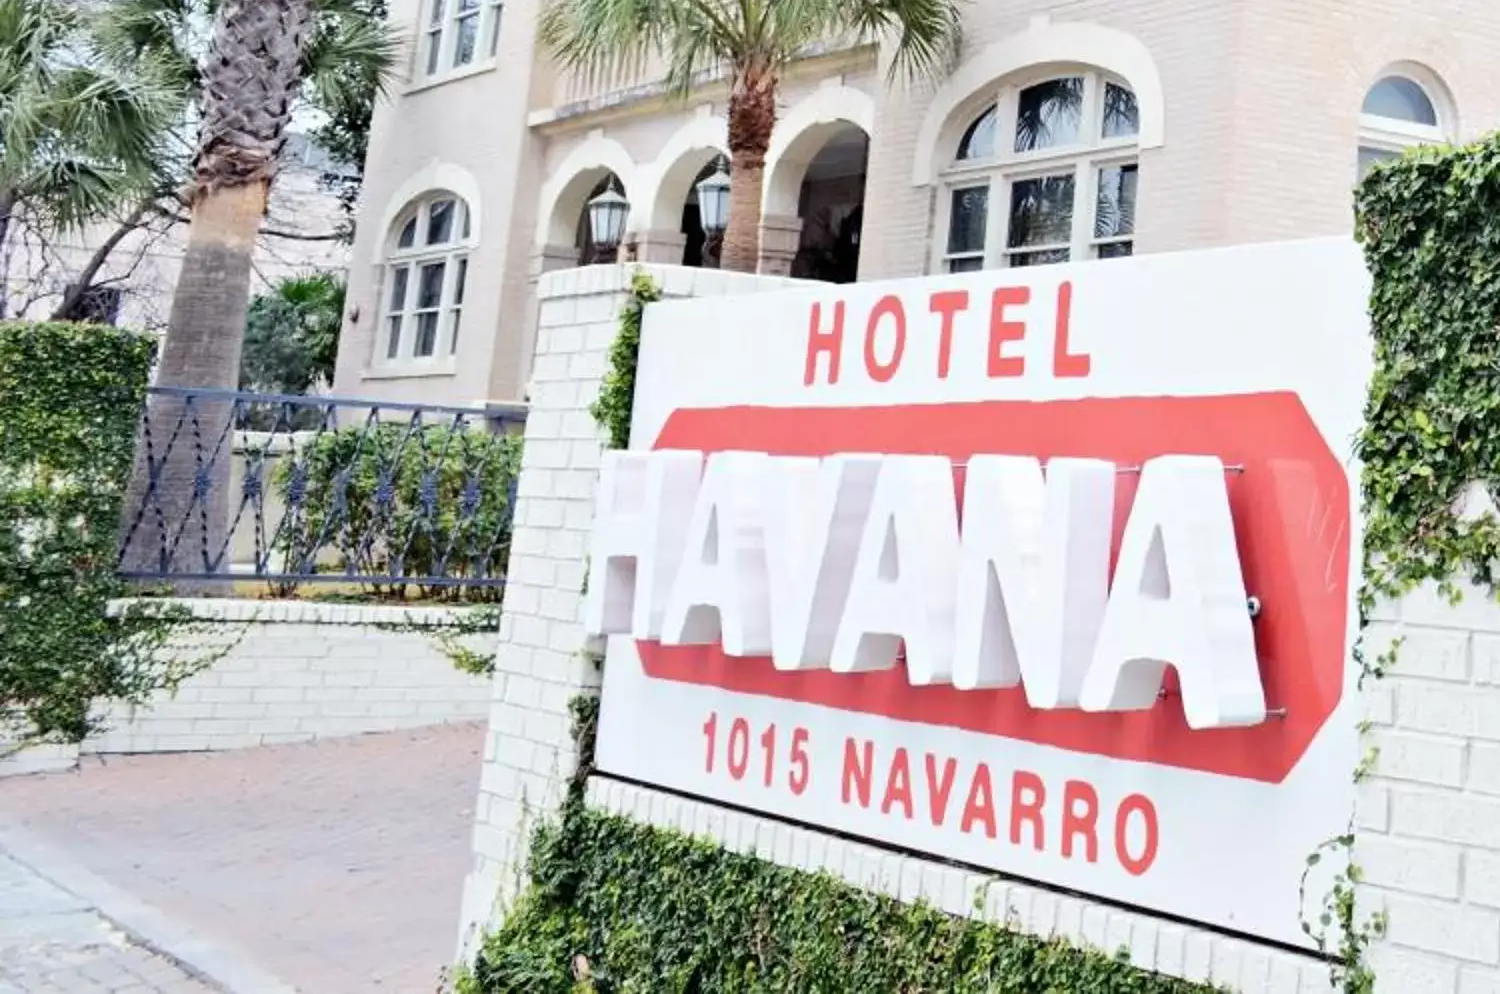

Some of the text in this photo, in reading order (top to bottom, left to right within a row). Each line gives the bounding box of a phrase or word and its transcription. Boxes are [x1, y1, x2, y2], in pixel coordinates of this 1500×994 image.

[803, 281, 1092, 386] HOTEL
[586, 449, 1266, 729] HAVANA
[702, 712, 1160, 877] 1015 NAVARRO
